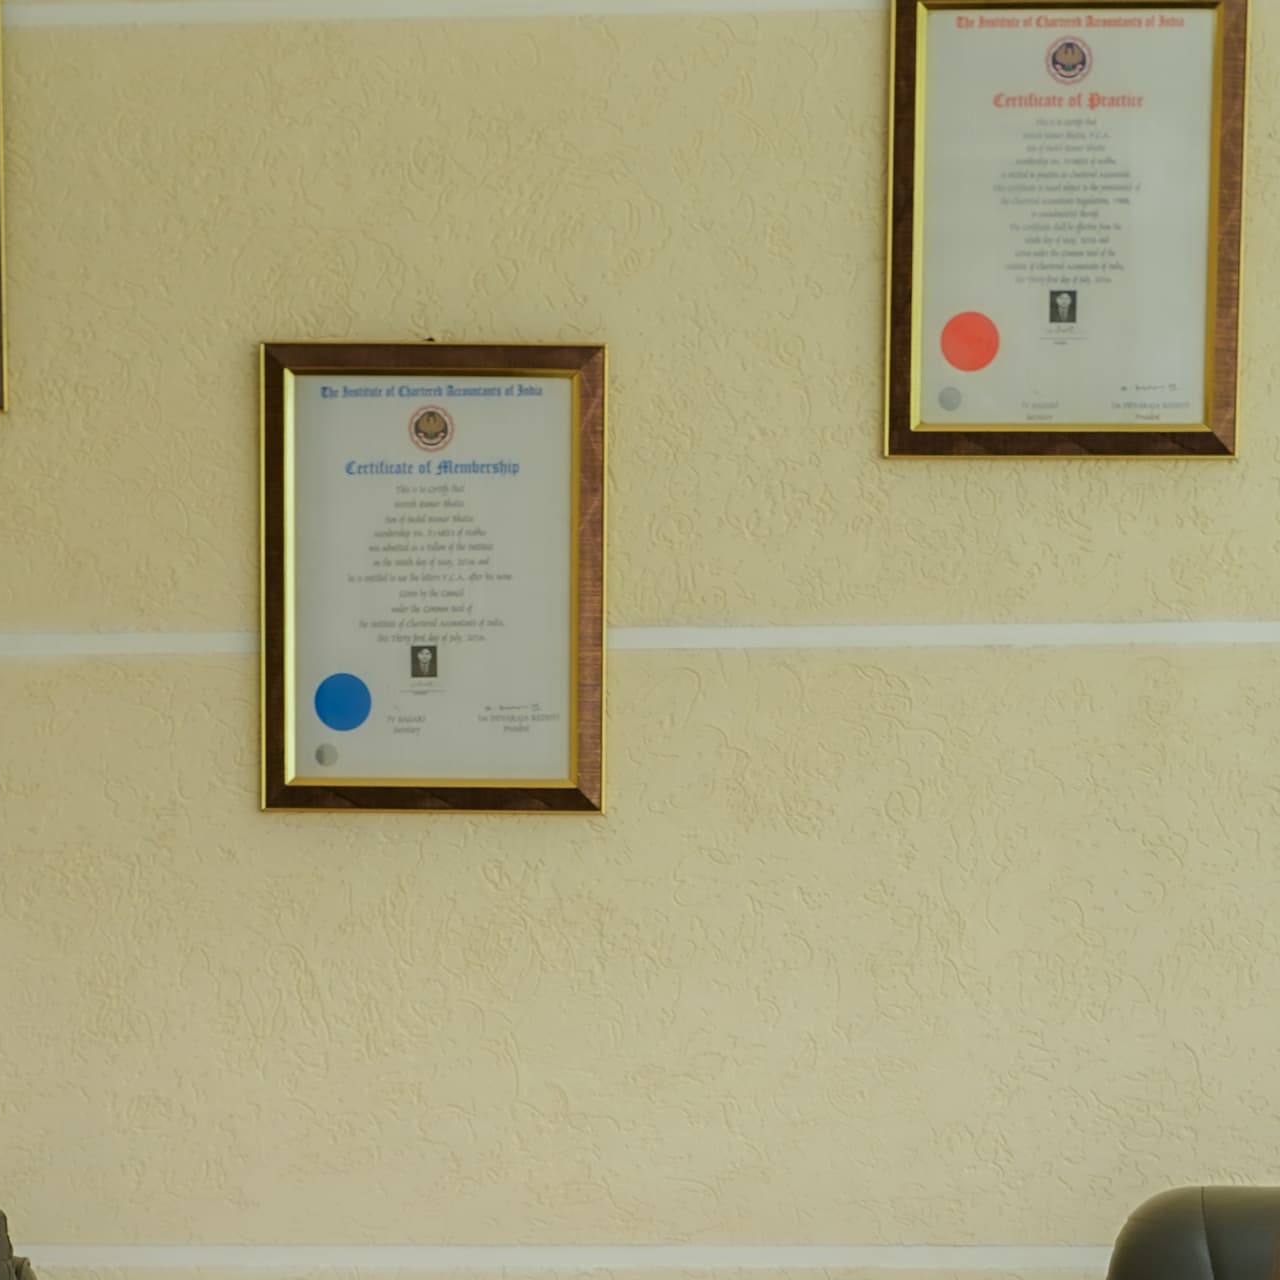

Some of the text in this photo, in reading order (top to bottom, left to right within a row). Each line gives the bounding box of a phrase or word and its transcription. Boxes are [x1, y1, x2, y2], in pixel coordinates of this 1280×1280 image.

[992, 92, 1144, 111] Certificate of Practice
[320, 383, 544, 399] The Institute of Chartered Accountants of India
[345, 459, 521, 477] Certificate of Membership
